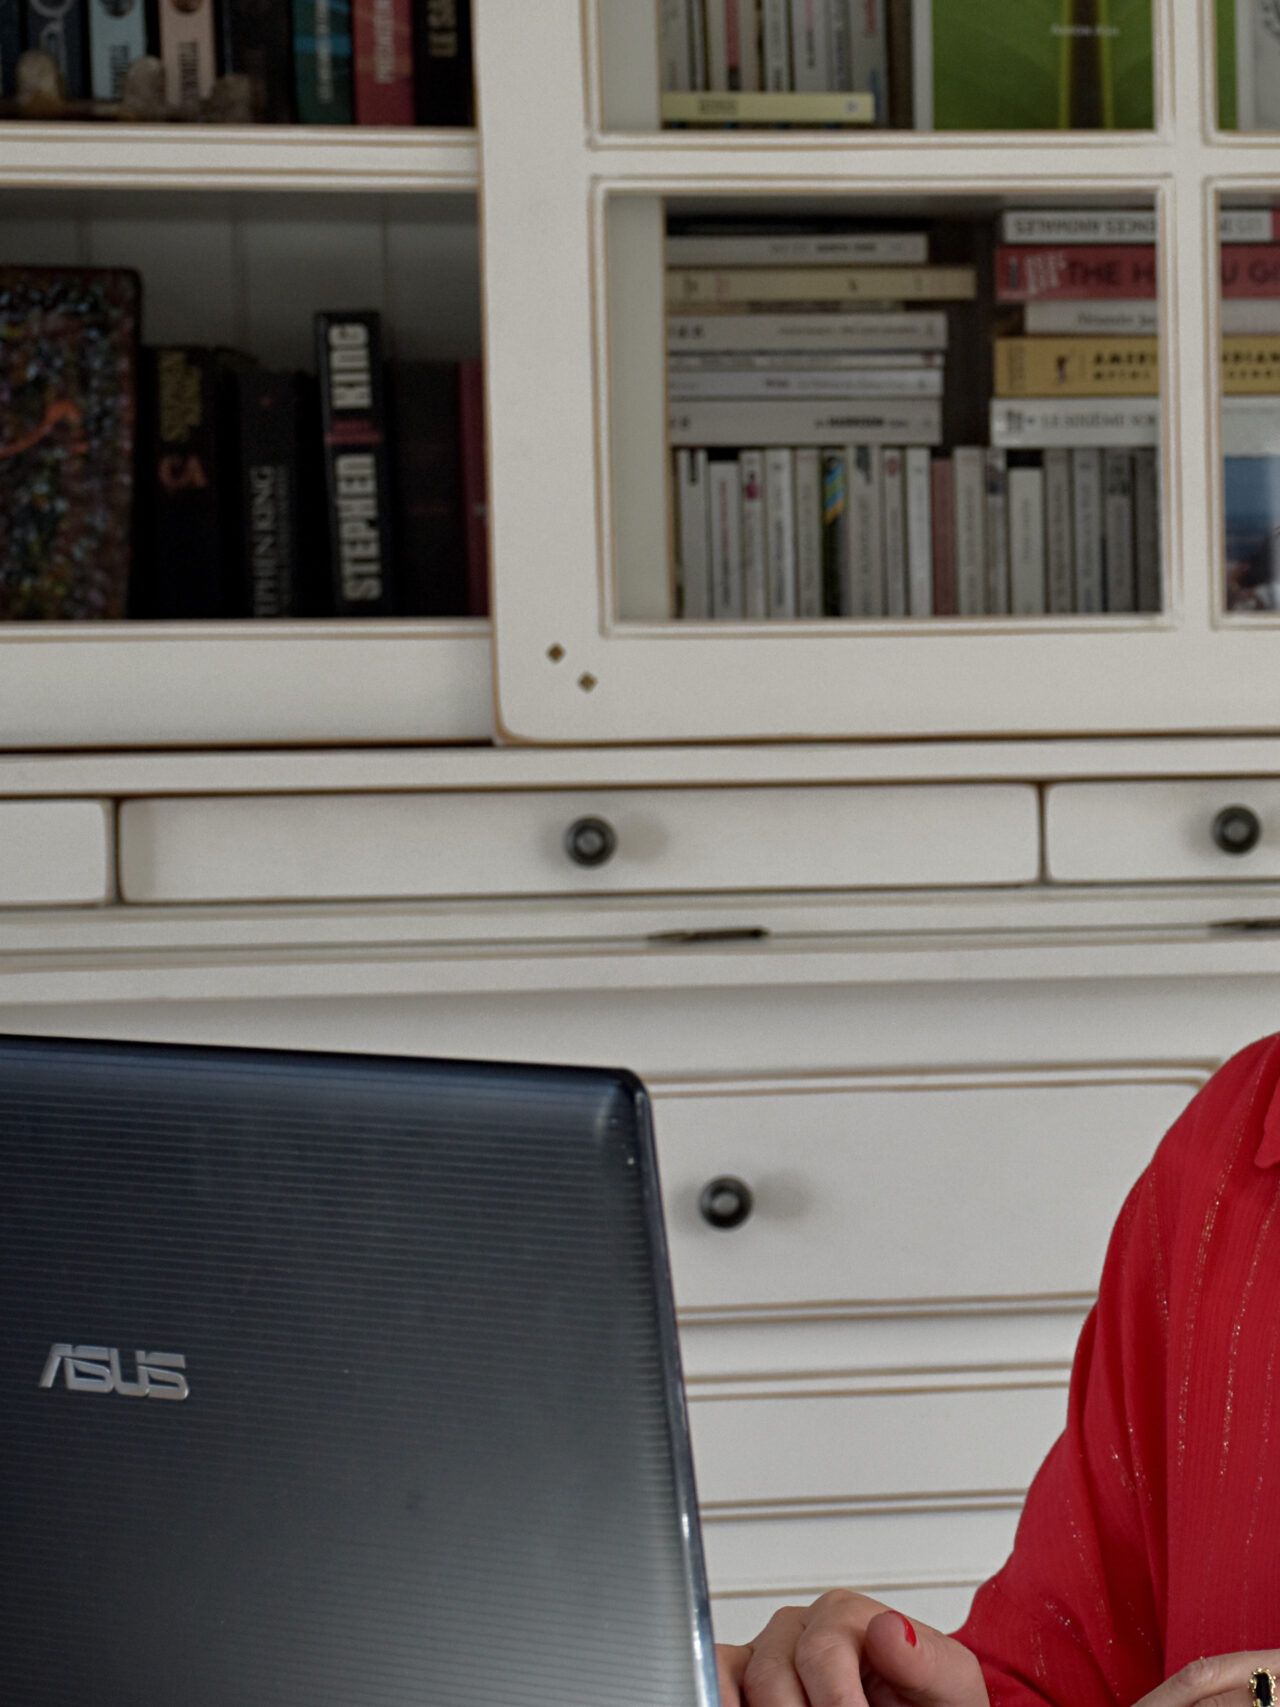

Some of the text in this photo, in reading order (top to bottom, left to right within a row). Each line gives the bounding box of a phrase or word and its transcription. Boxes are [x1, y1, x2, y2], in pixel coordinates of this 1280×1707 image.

[1068, 259, 1121, 287] THE
[327, 322, 384, 602] STEPHEN KING
[38, 1343, 190, 1401] ASUS
